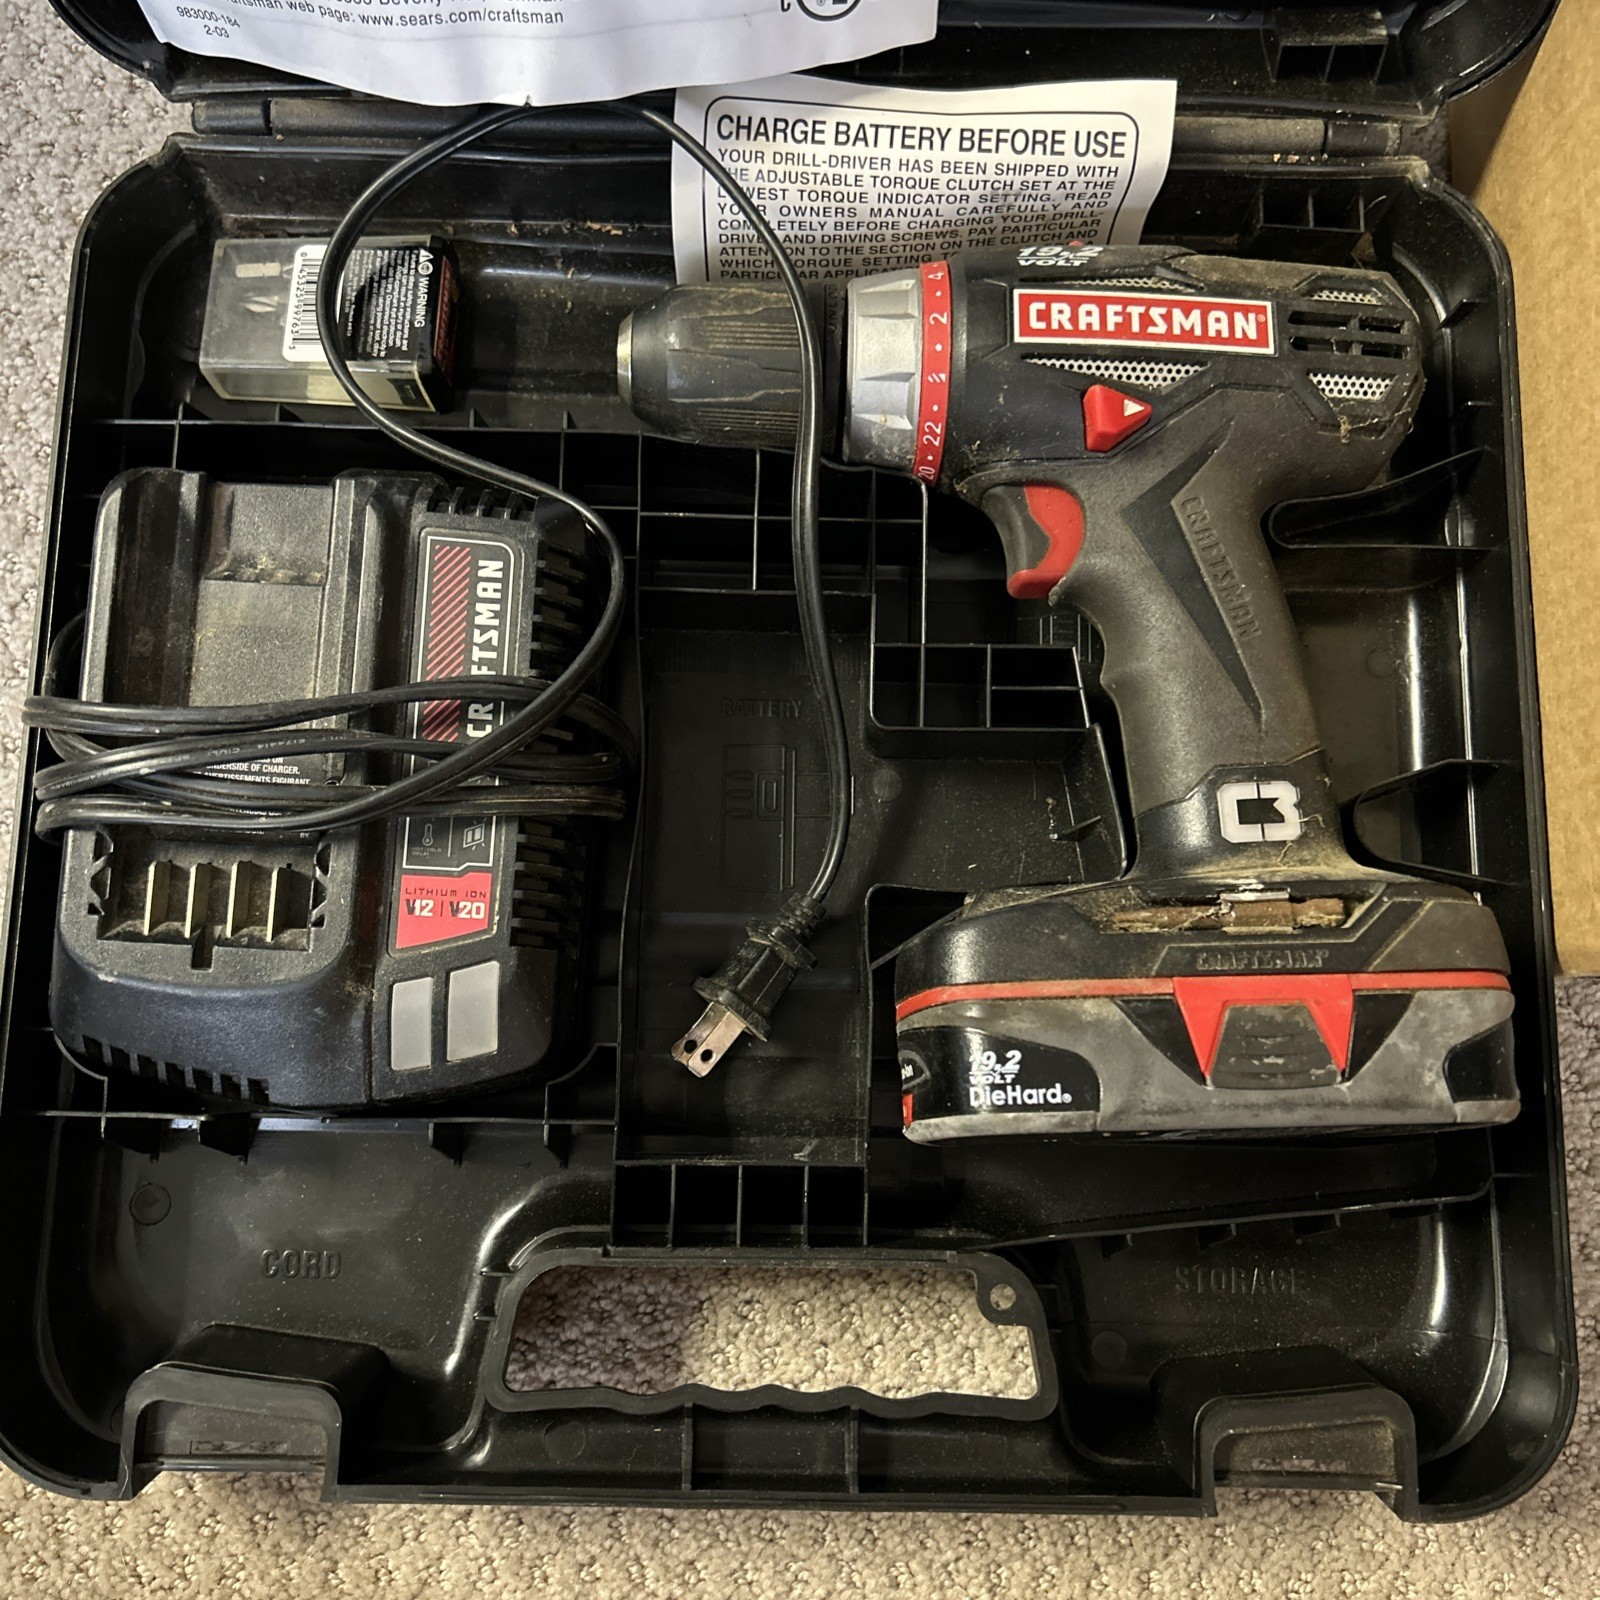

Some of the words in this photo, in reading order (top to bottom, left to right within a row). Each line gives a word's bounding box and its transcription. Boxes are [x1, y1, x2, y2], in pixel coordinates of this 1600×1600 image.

[176, 6, 240, 28] 983000-184
[227, 0, 284, 9] aftsman
[286, 0, 315, 13] web
[318, 5, 356, 23] page:
[359, 8, 564, 26] www.sears.com/craftsman
[204, 25, 230, 38] 2-03
[717, 114, 827, 145] CHARGE
[834, 121, 952, 151] BATTERY
[959, 128, 1066, 156] BEFORE
[1074, 130, 1127, 158] USE
[718, 148, 765, 165] YOUR
[773, 151, 891, 171] DRILL-DRIVER
[899, 158, 933, 173] HAS
[941, 161, 987, 175] BEEN
[994, 163, 1069, 177] SHIPPED
[1076, 166, 1119, 178] WITH
[725, 167, 749, 182] HE
[755, 169, 864, 187] ADJUSTABLE
[870, 175, 940, 191] TORQUE
[946, 179, 1014, 191] CLUTCH
[1019, 180, 1052, 190] SET
[1056, 181, 1078, 190] AT
[1082, 181, 1115, 190] THE
[718, 186, 789, 201] LWEST
[797, 189, 868, 203] TORQUE
[878, 193, 970, 204] INDICATOR
[978, 193, 1056, 204] SETTING.
[1064, 192, 1112, 201] READ
[718, 202, 767, 216] YOR
[779, 205, 857, 218] OWNERS
[869, 207, 944, 218] MANUAL
[956, 202, 1060, 216] CAREFULLY
[1071, 200, 1109, 210] AND
[718, 219, 828, 231] COMETELY
[833, 220, 901, 231] BEFORE
[907, 217, 994, 230] CHARGING
[999, 213, 1045, 224] YOUR
[1052, 210, 1104, 221] DRILL-
[719, 233, 764, 244] DRIV
[782, 234, 816, 244] AND
[821, 233, 886, 244] DRIVING
[890, 230, 963, 242] SCREWS.
[968, 226, 998, 237] PAY
[1001, 219, 1102, 234] PARTICULAR
[719, 246, 805, 257] ATTENON
[809, 246, 830, 256] TO
[834, 246, 864, 255] THE
[868, 242, 936, 255] SECTION
[940, 240, 962, 250] ON
[967, 238, 996, 249] THE
[1000, 232, 1062, 245] CLUTCH
[1065, 229, 1098, 240] AND
[720, 258, 774, 268] WHICH
[793, 258, 853, 268] ORQUE
[862, 253, 932, 266] SETTING
[1018, 259, 1088, 267] VOLT
[295, 269, 306, 299] 45325
[721, 270, 818, 280] PARTICAR
[928, 272, 945, 280] 4
[414, 277, 429, 327] WARNING
[291, 303, 303, 335] 99763
[930, 312, 947, 325] 2
[1029, 302, 1258, 341] CRAFTSMAN
[923, 421, 942, 446] 22
[918, 465, 935, 480] 20
[1182, 496, 1262, 640] CRAFTSMAN
[466, 560, 504, 738] CRFTSMAN
[721, 698, 802, 718] BATTERY
[207, 762, 249, 772] DERSIDE
[250, 763, 262, 773] OF
[262, 764, 301, 775] CHARGER.
[405, 887, 453, 897] LITHIUM
[466, 890, 487, 898] ION
[405, 899, 434, 917] V12
[449, 901, 486, 919] V20
[969, 1050, 1022, 1073] 19.2
[969, 1074, 1016, 1085] VOLT
[969, 1083, 1063, 1107] DieHard
[261, 1247, 342, 1280] CORD
